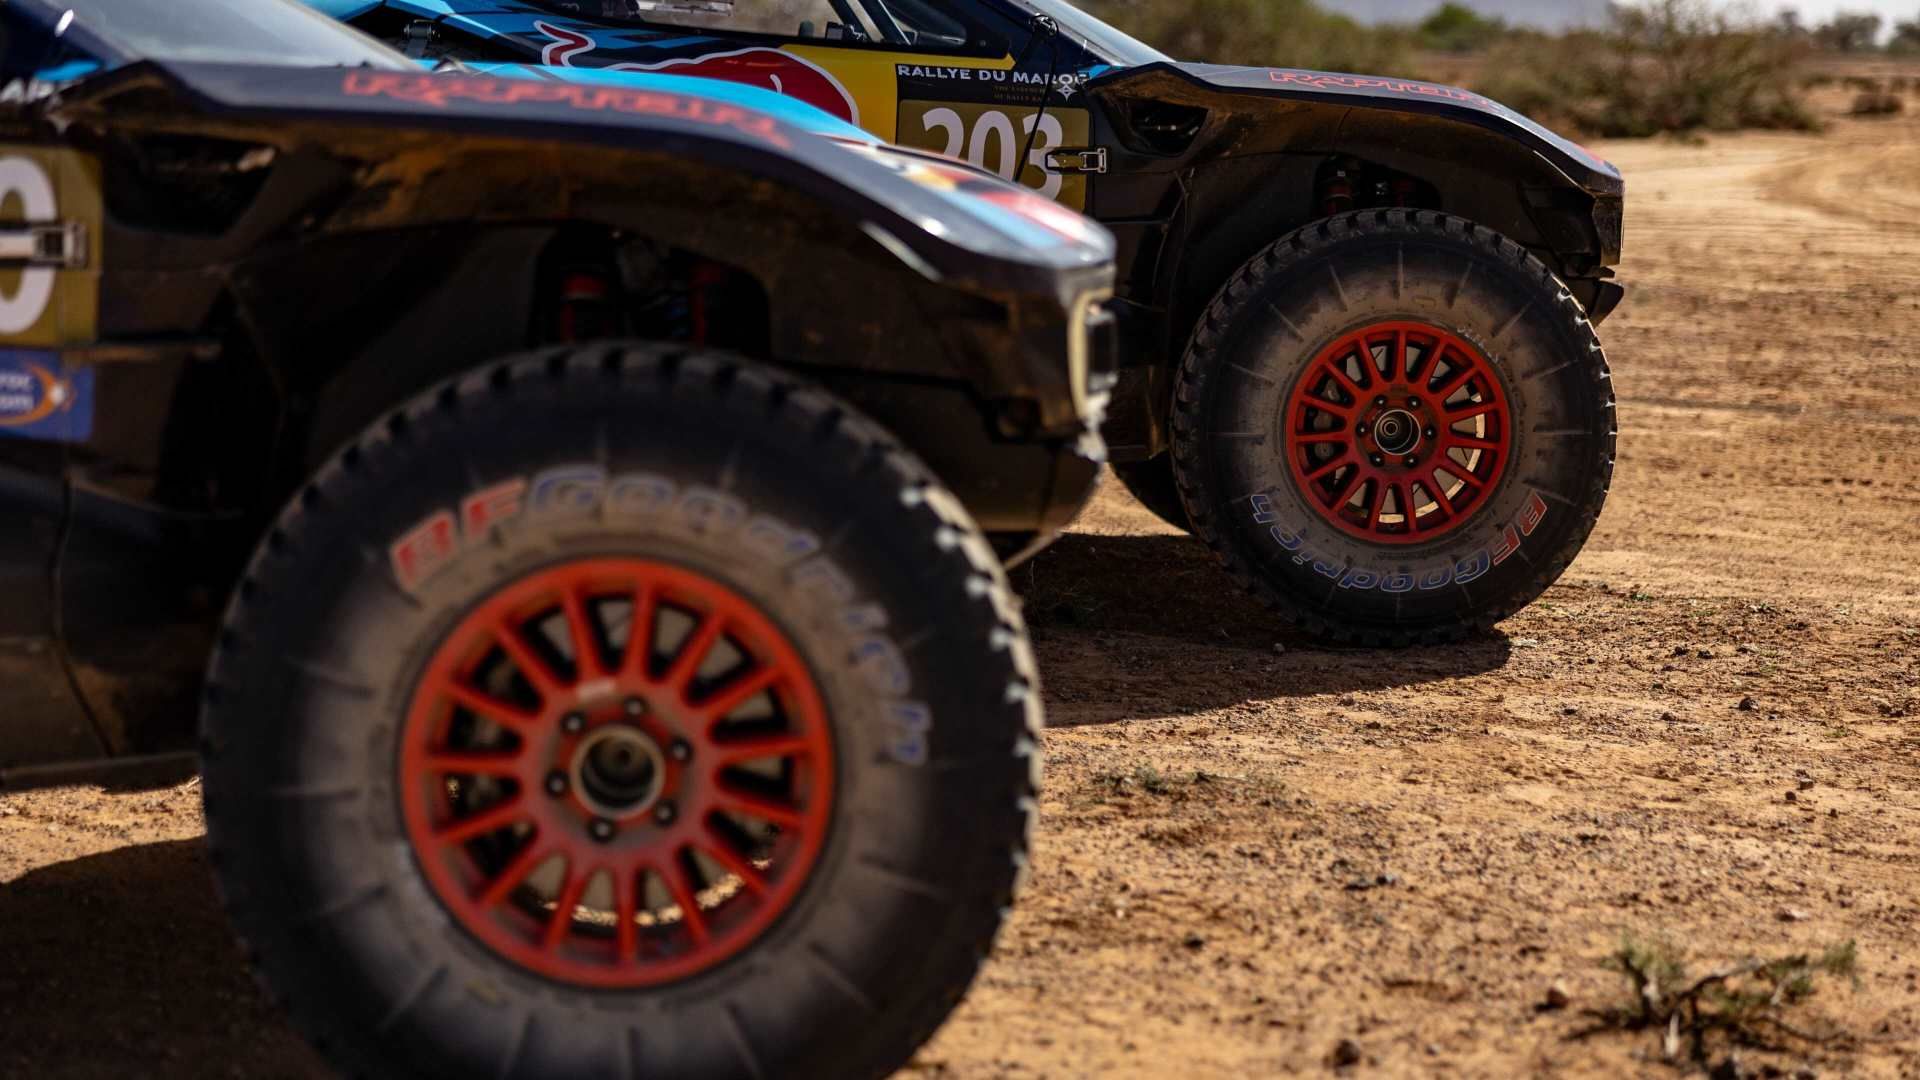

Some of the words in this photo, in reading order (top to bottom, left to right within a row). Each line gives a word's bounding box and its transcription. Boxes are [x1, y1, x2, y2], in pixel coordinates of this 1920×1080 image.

[898, 65, 971, 80] RALLYE
[979, 70, 1006, 82] DU
[922, 107, 1063, 200] 203
[1251, 492, 1548, 593] BFGoodrich
[390, 466, 933, 766] BFGoodrich
